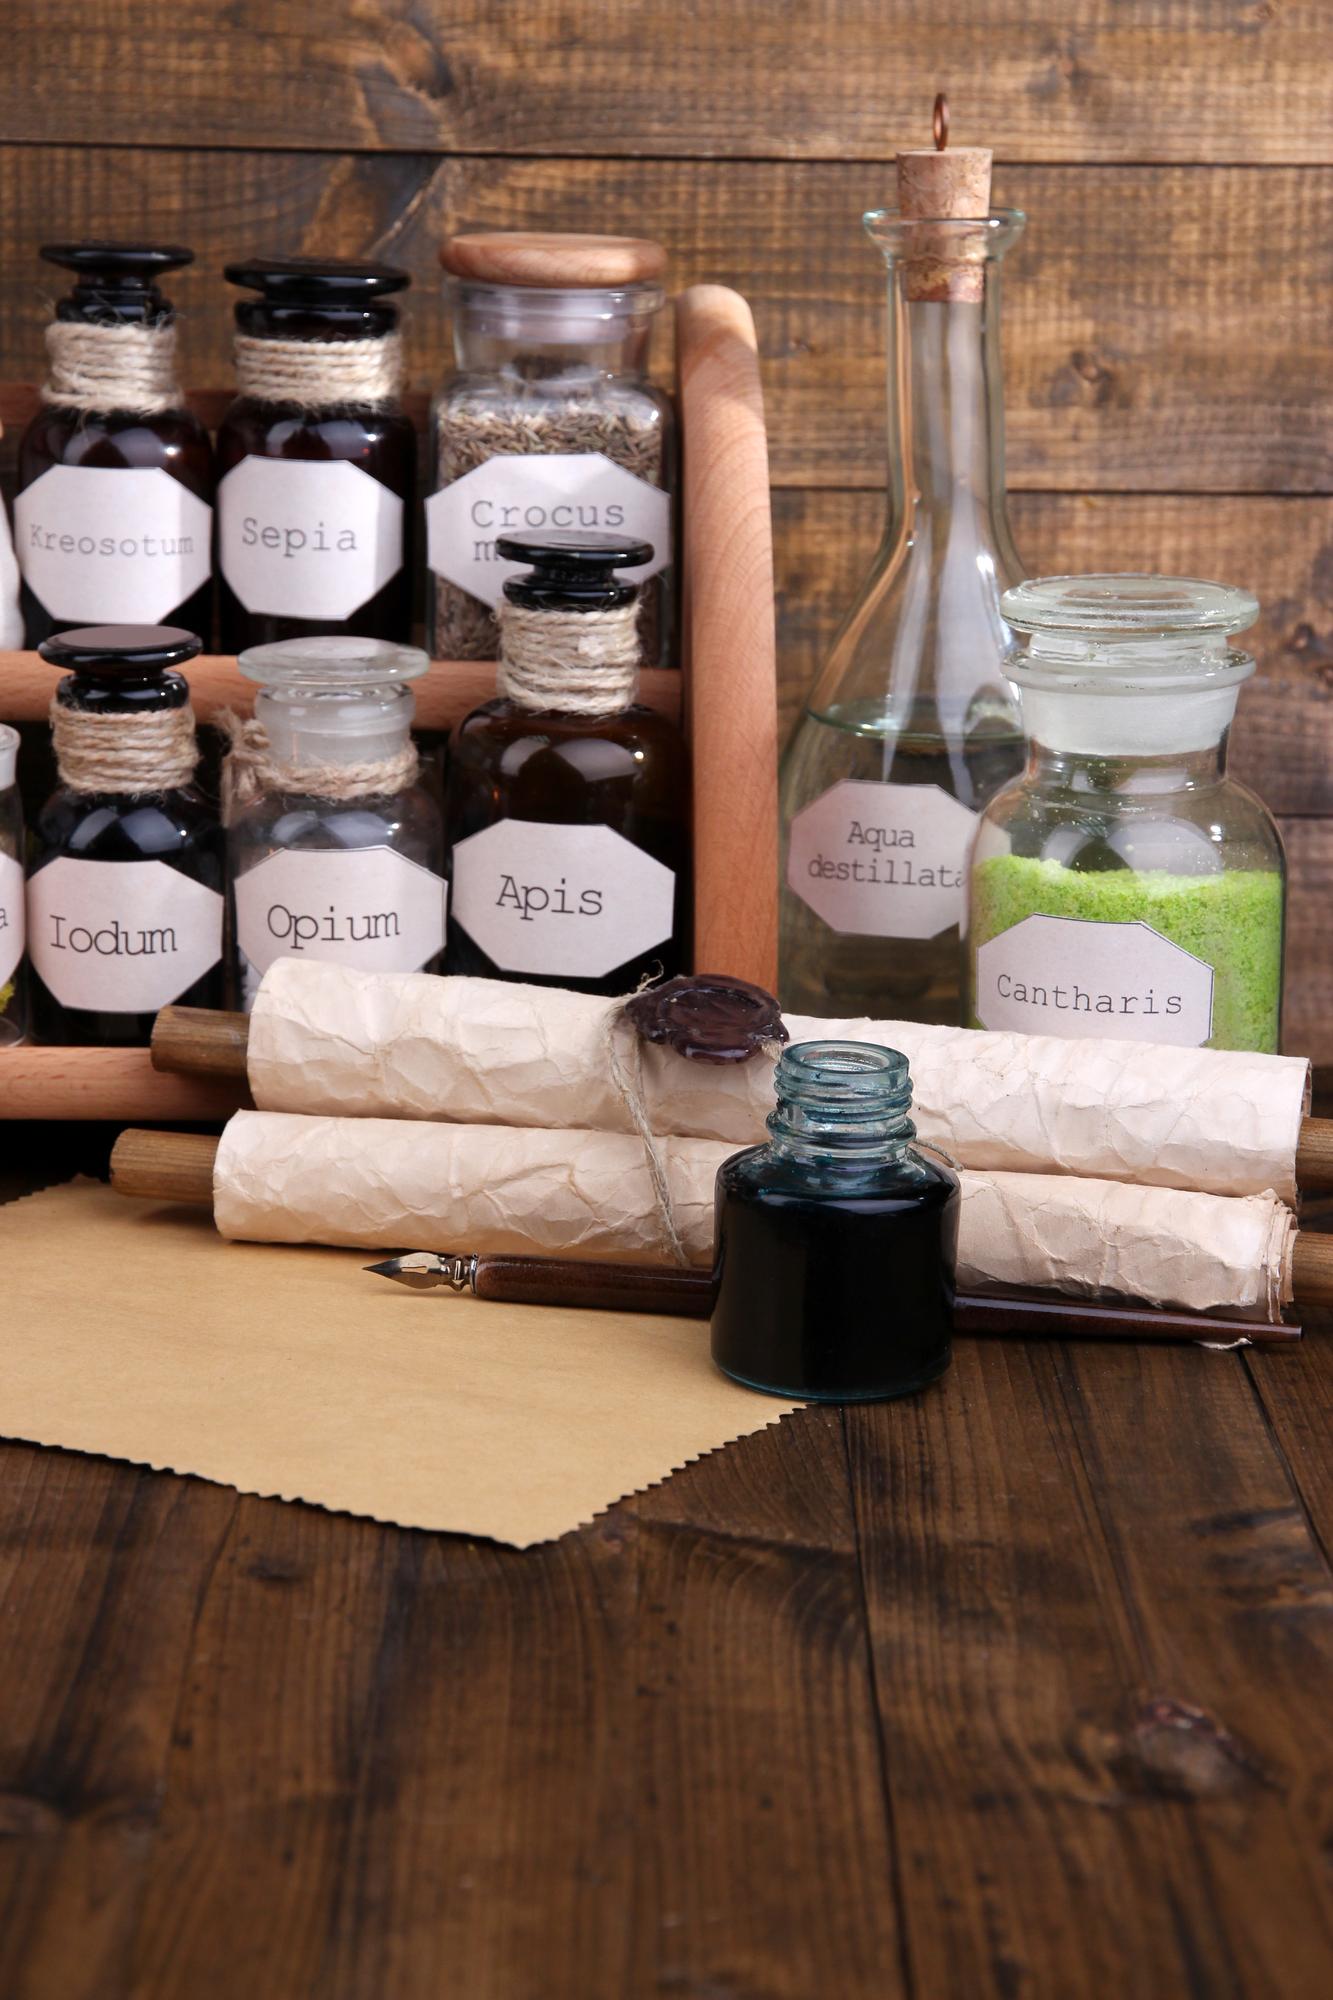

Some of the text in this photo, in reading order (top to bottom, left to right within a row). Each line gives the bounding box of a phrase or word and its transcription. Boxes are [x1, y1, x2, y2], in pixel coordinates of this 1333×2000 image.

[471, 500, 625, 528] Crocus
[29, 523, 195, 557] Kreosotum
[242, 517, 357, 558] Sepia
[847, 821, 916, 852] Aqua
[496, 874, 603, 921] Apis
[50, 914, 178, 955] Iodum
[267, 904, 400, 950] Opium
[997, 974, 1183, 1015] Cantharis
